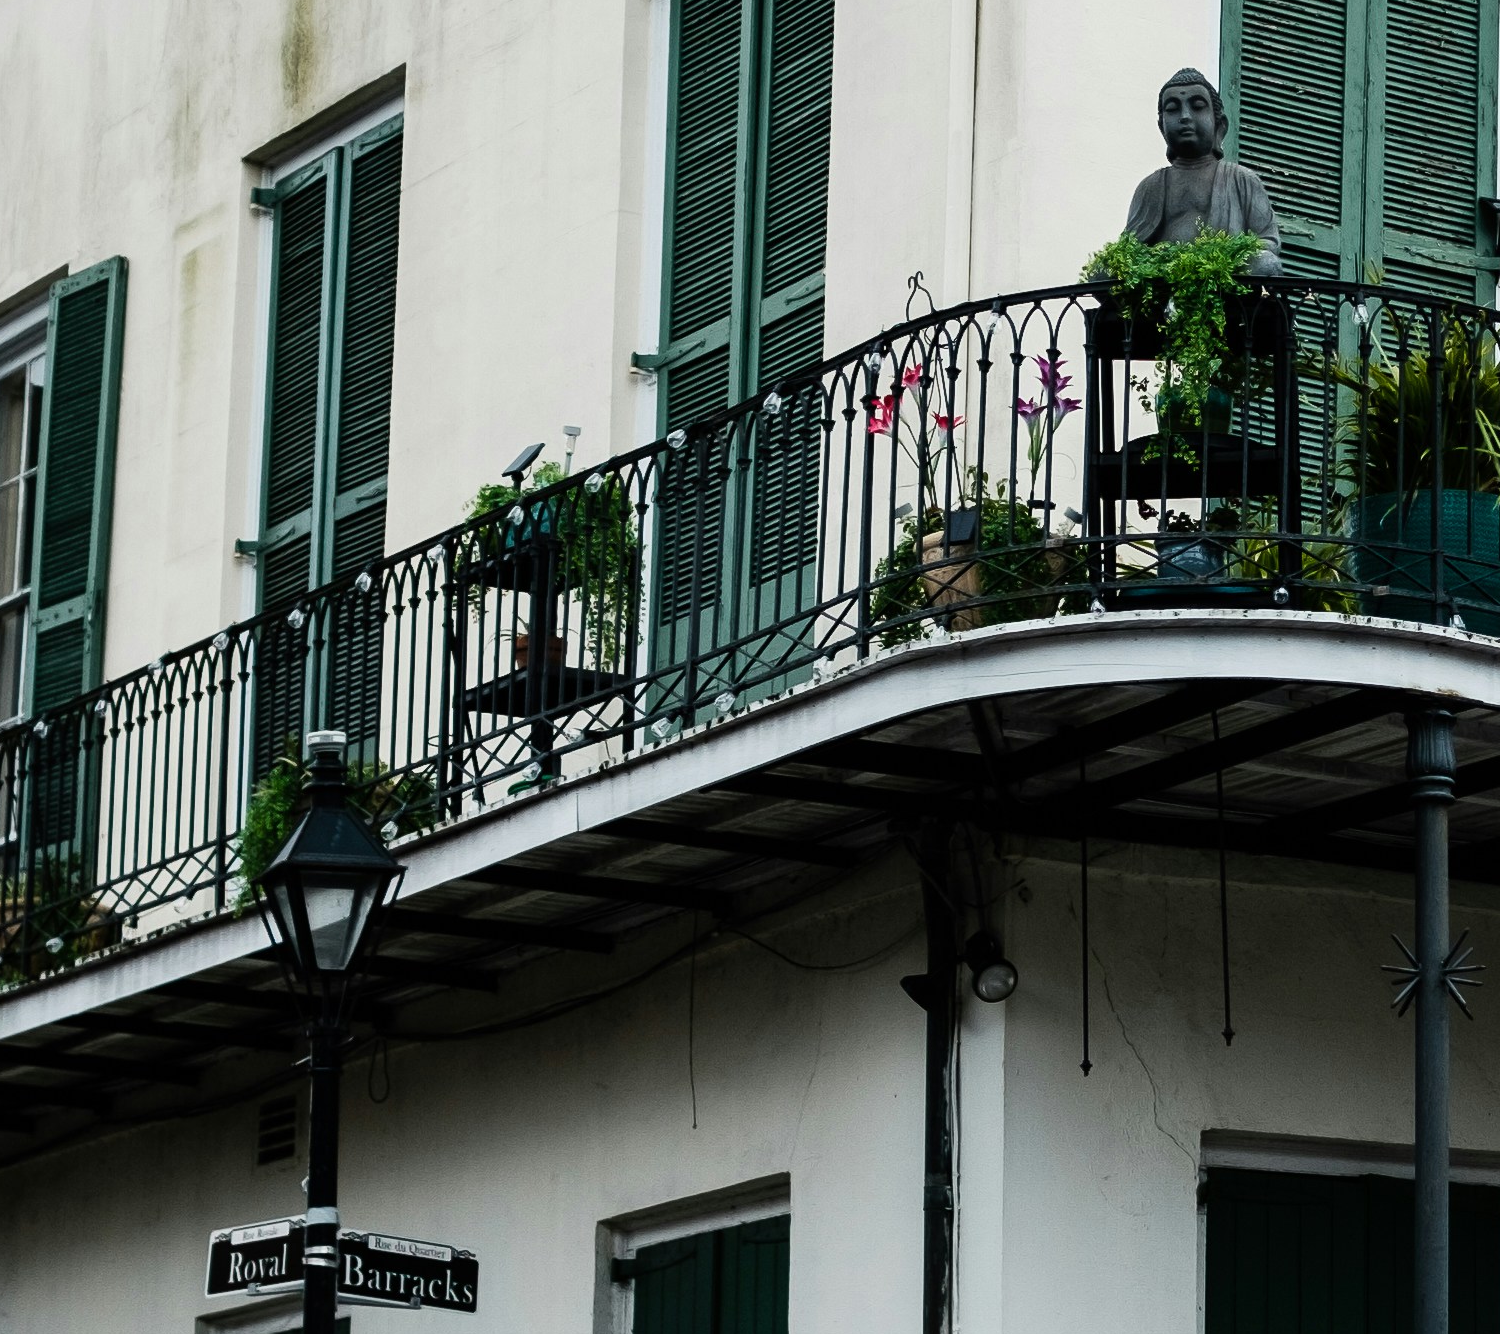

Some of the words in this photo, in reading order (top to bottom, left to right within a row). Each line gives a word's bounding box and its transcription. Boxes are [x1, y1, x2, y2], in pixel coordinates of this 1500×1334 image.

[228, 1243, 287, 1284] Royal
[374, 1237, 392, 1250] Rue
[394, 1241, 406, 1253] du
[343, 1254, 473, 1305] Barracks
